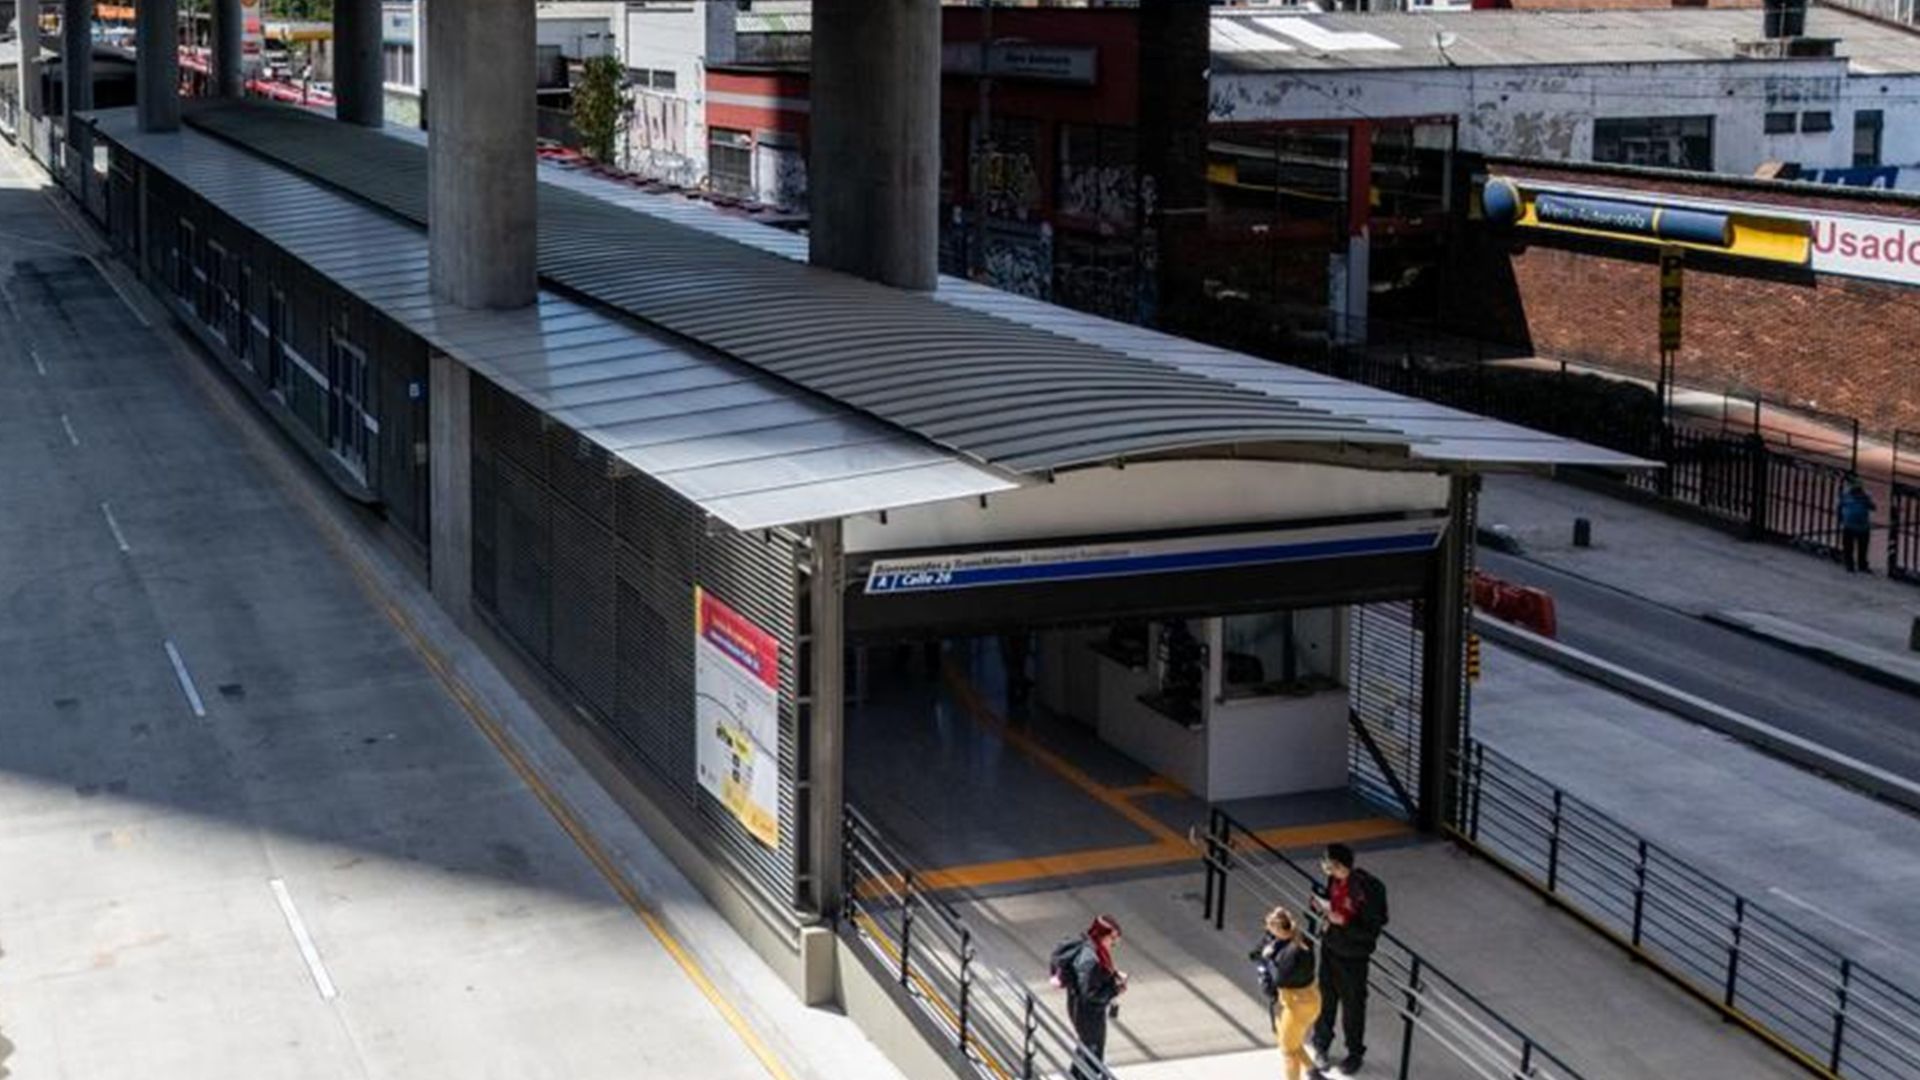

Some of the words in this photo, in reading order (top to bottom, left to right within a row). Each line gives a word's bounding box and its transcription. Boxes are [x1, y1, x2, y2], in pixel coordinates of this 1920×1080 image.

[953, 554, 1022, 571] TransMilenio
[877, 576, 888, 588] A
[901, 573, 932, 586] Calle
